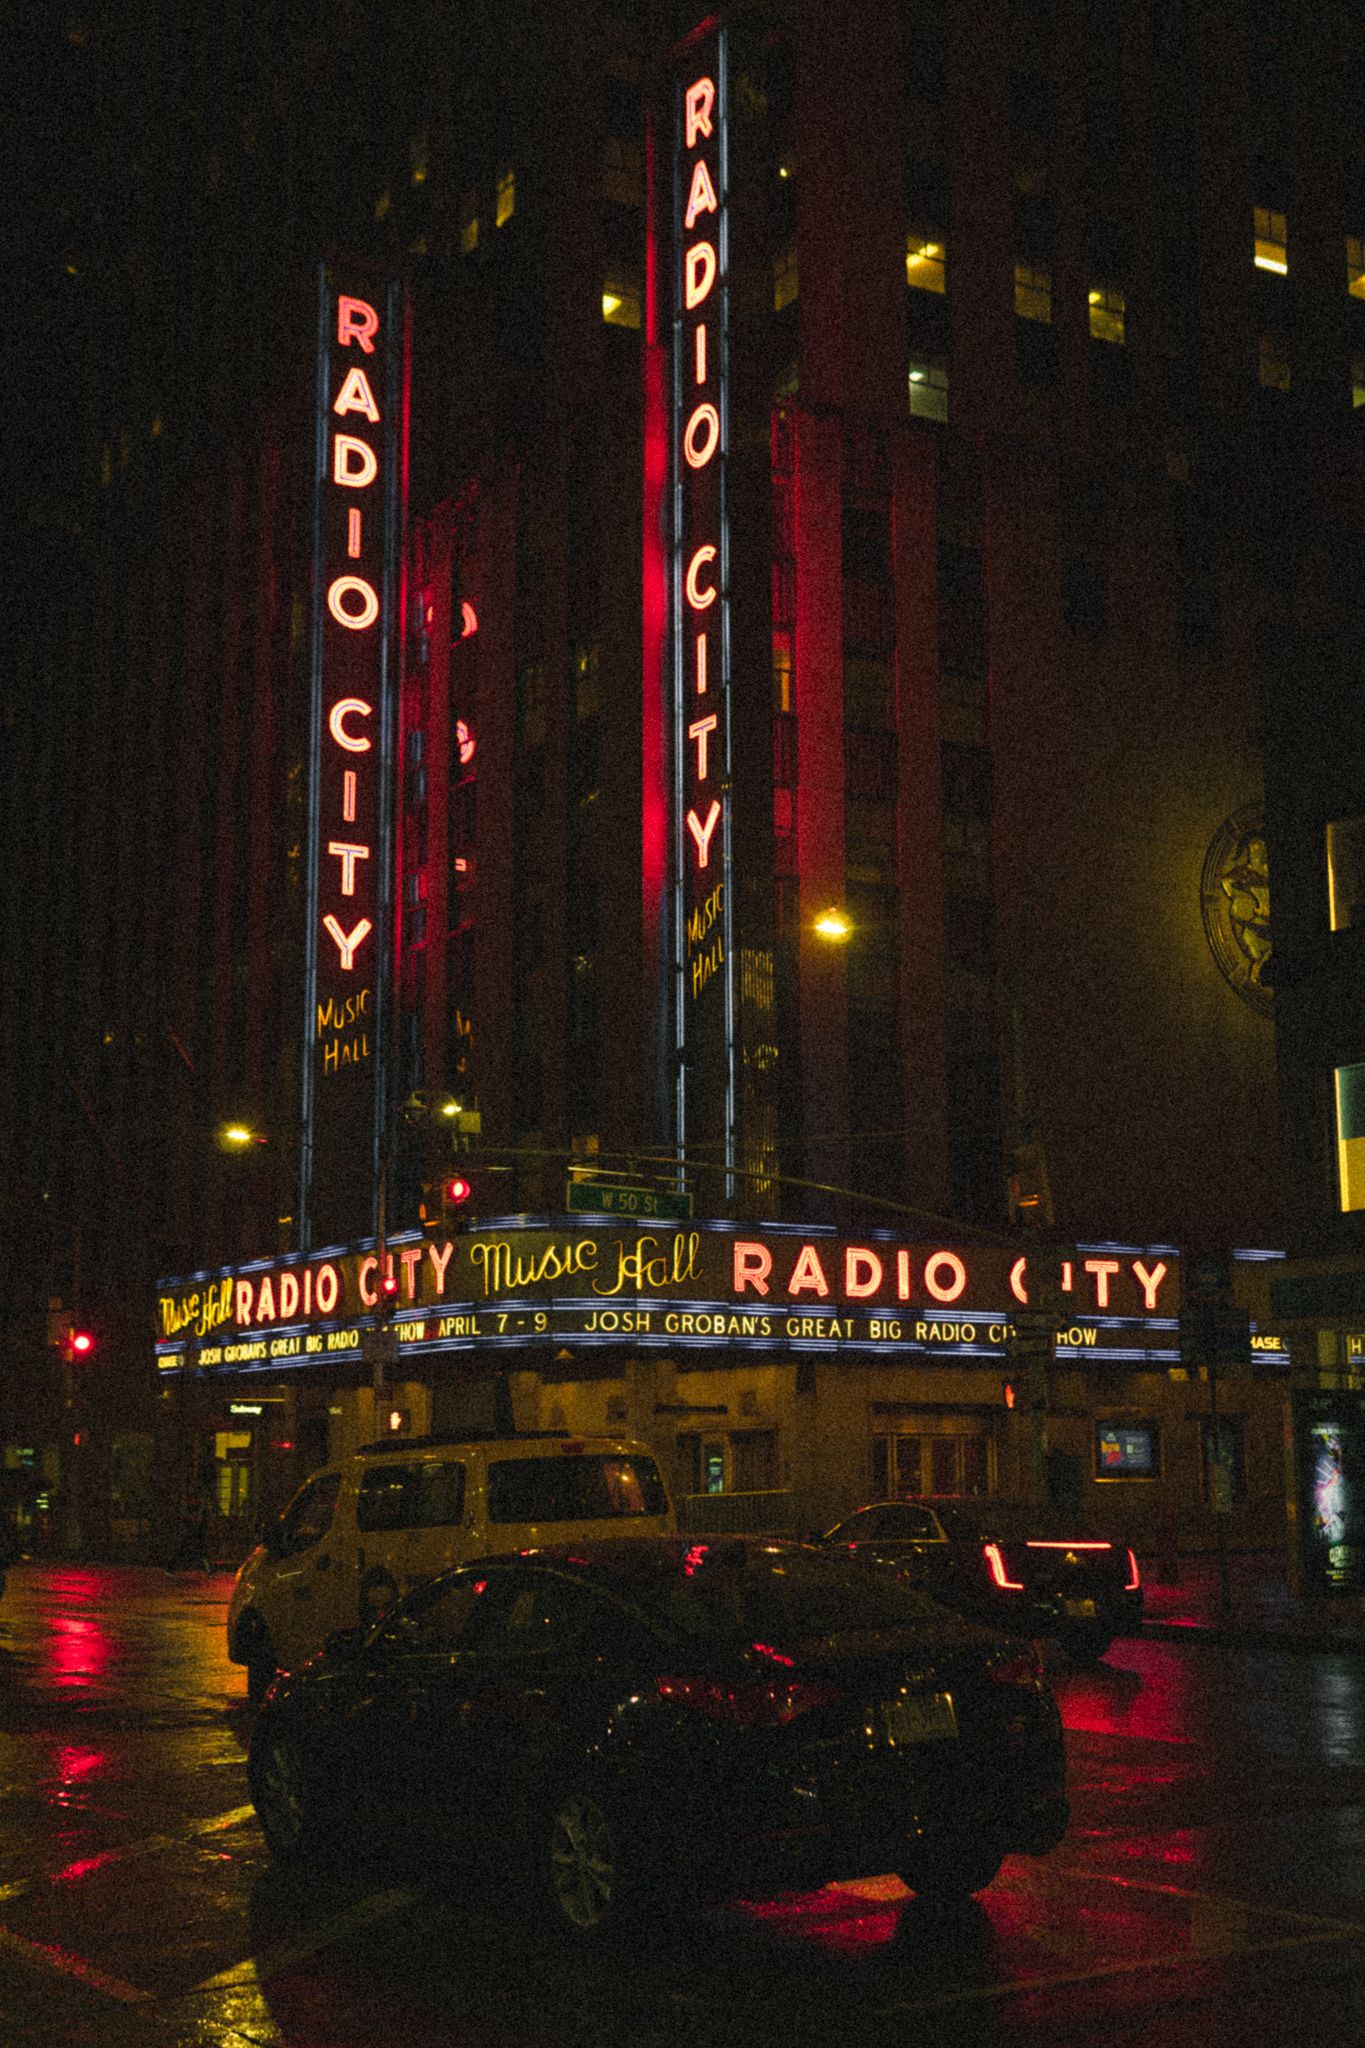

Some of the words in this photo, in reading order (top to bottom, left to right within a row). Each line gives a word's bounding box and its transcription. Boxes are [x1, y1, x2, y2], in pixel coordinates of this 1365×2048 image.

[684, 77, 719, 469] RADIO
[327, 295, 380, 630] RADIO
[686, 545, 721, 868] CITY
[322, 698, 373, 971] CITY
[602, 1191, 614, 1208] W
[619, 1193, 638, 1211] 50
[470, 1242, 599, 1296] Music
[592, 1231, 704, 1296] Hall
[733, 1241, 967, 1302] RADIO
[195, 1277, 234, 1337] Hall
[236, 1264, 339, 1326] RADIO
[438, 1315, 481, 1338] APRIL
[497, 1313, 508, 1333] 7
[534, 1312, 548, 1333] 9
[270, 1337, 300, 1357] GREAT
[306, 1334, 323, 1353] BIG
[327, 1329, 359, 1351] RADIO
[583, 1311, 651, 1333] JOSH
[664, 1313, 772, 1337] GROBAN'S
[785, 1317, 855, 1339] GREAT
[868, 1320, 902, 1340] BIG
[915, 1321, 977, 1343] RADIO
